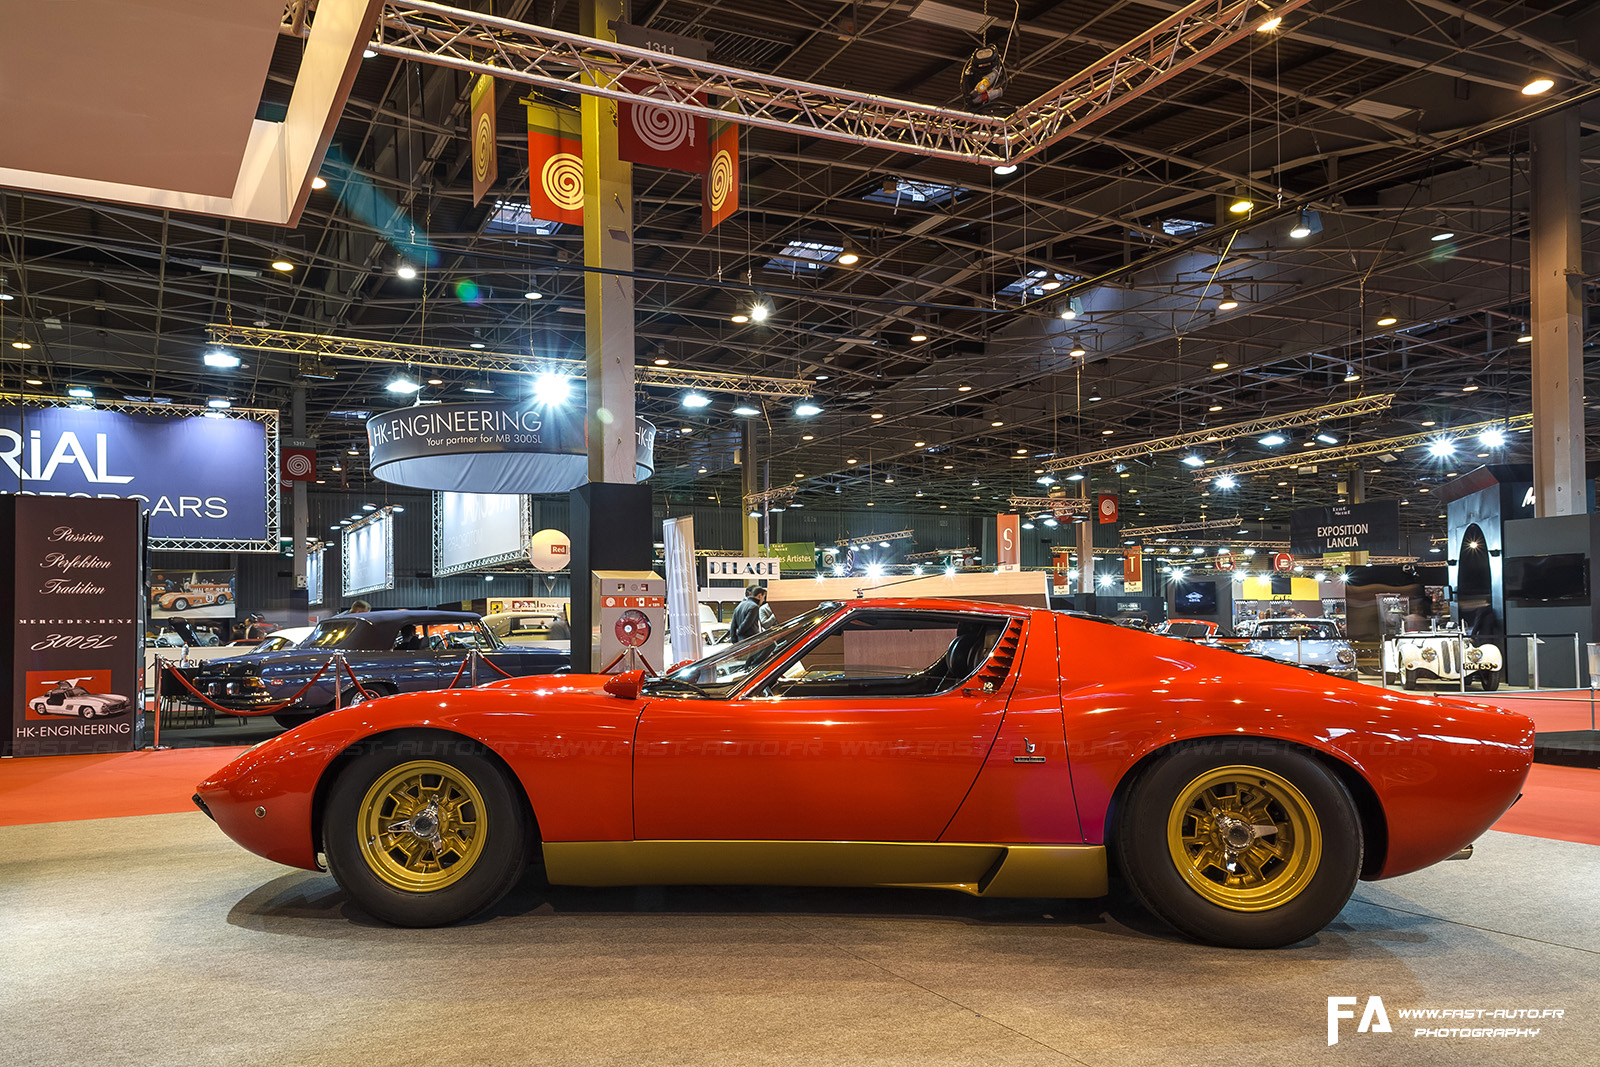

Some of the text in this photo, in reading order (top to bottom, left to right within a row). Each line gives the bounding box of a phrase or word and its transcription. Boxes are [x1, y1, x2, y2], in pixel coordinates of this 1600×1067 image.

[372, 410, 542, 447] HK-ENGINEERING
[426, 433, 542, 446] Your partner for MB 300SL
[47, 526, 105, 543] Passion
[1317, 524, 1369, 537] EXPOSITION
[1326, 536, 1359, 548] LANCIA
[39, 552, 112, 573] Perfektion
[786, 554, 812, 563] Artistes
[710, 561, 778, 575] DELAGE
[38, 578, 106, 595] Tradition
[16, 723, 131, 738] HK-ENGINEERING
